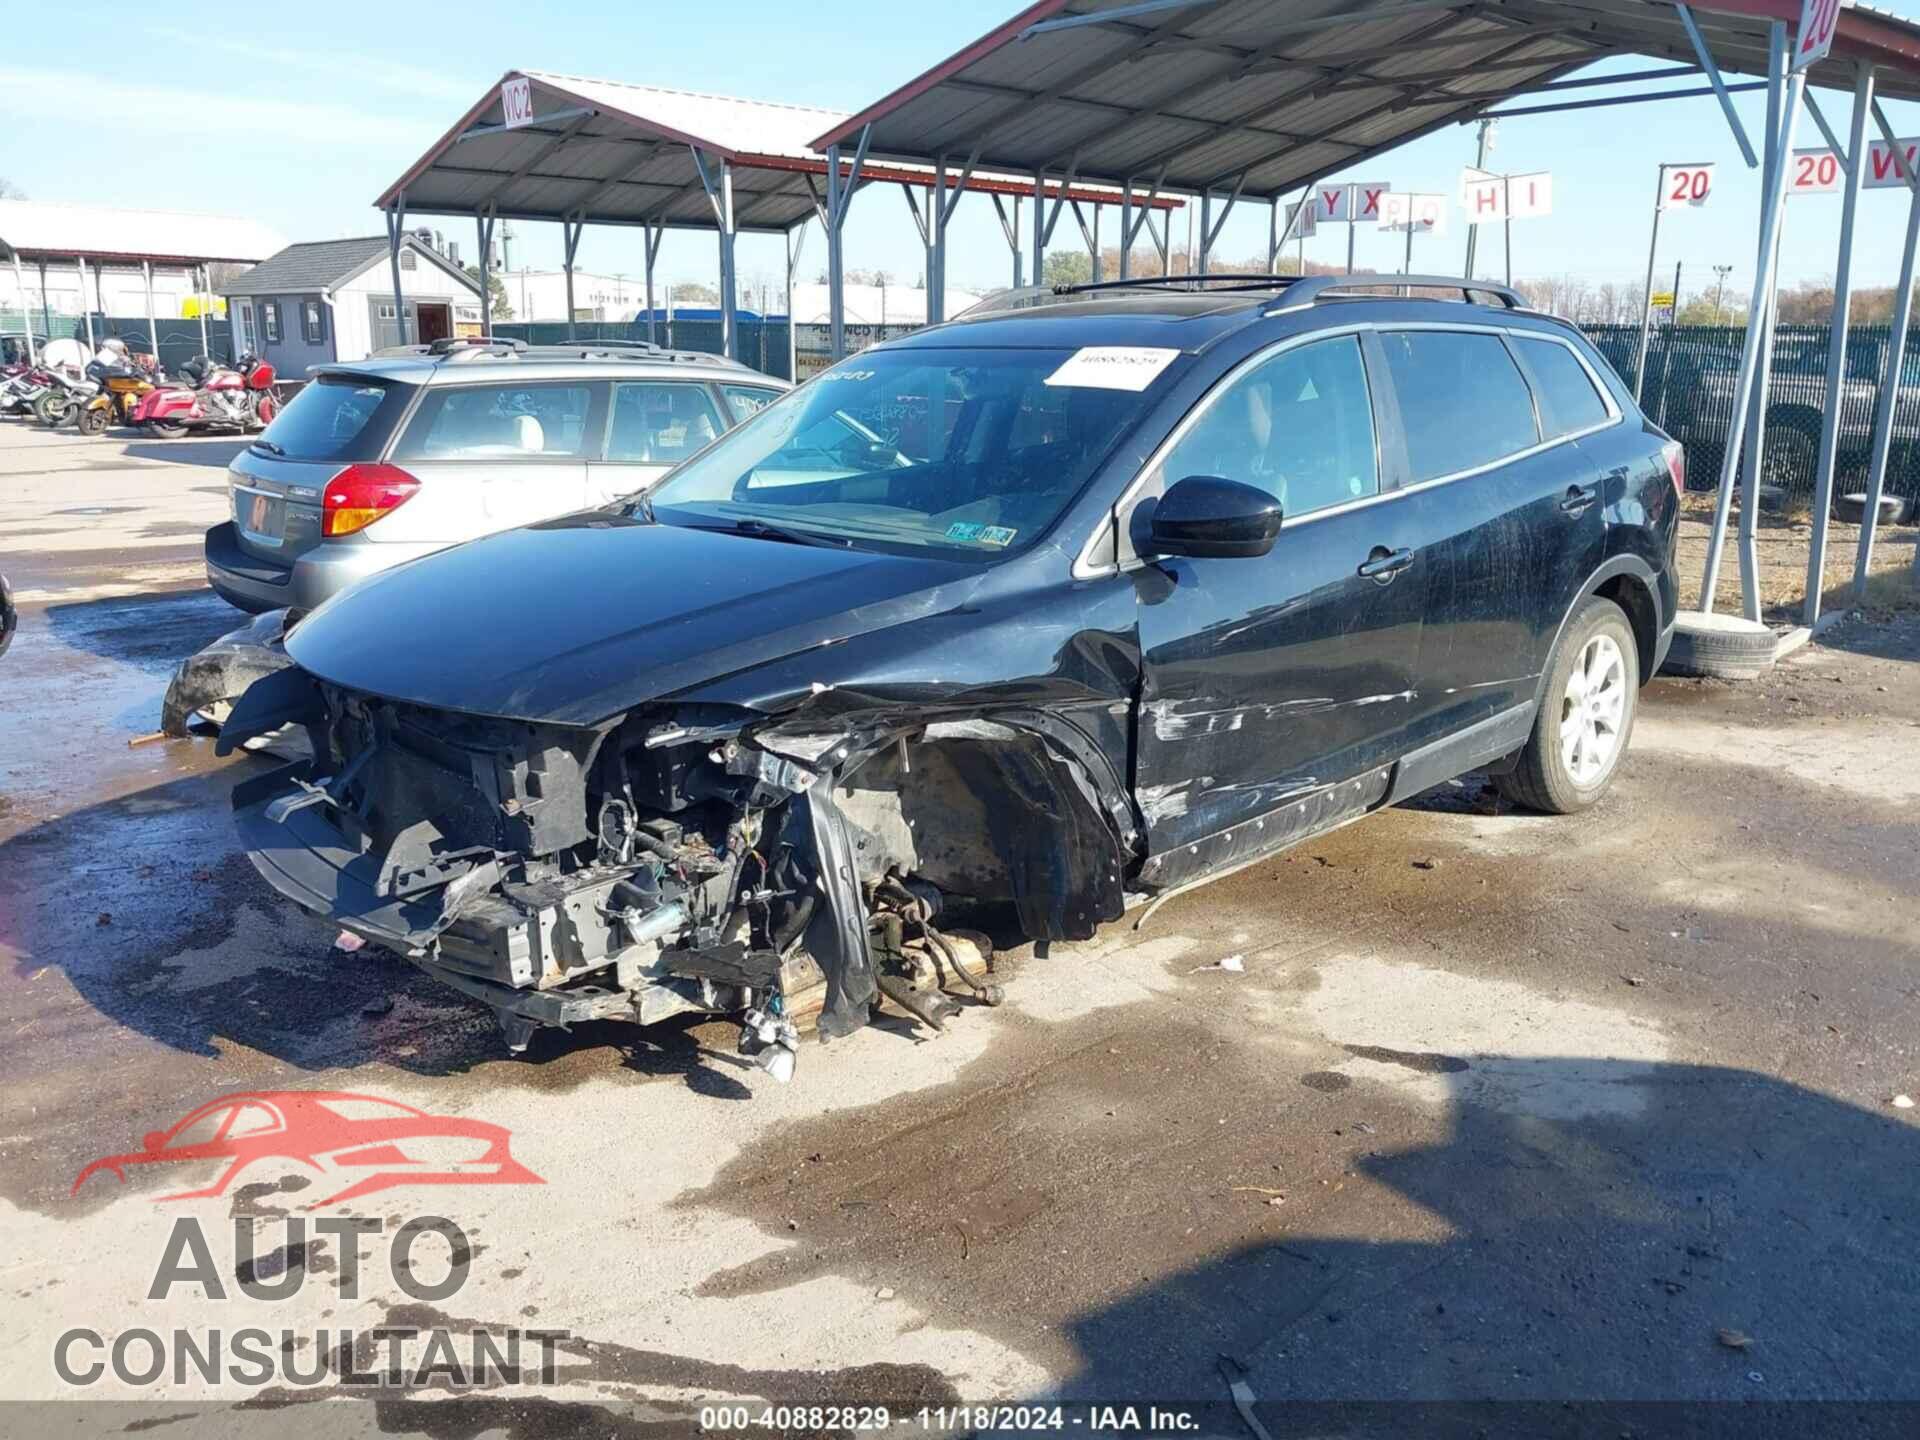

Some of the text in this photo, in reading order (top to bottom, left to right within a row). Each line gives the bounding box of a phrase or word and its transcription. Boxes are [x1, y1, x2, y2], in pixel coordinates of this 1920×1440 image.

[1795, 155, 1837, 187] 20
[1529, 181, 1535, 207] I
[1671, 171, 1709, 201] 20
[1322, 191, 1341, 215] Y
[1362, 189, 1382, 214] X
[1477, 187, 1497, 213] H
